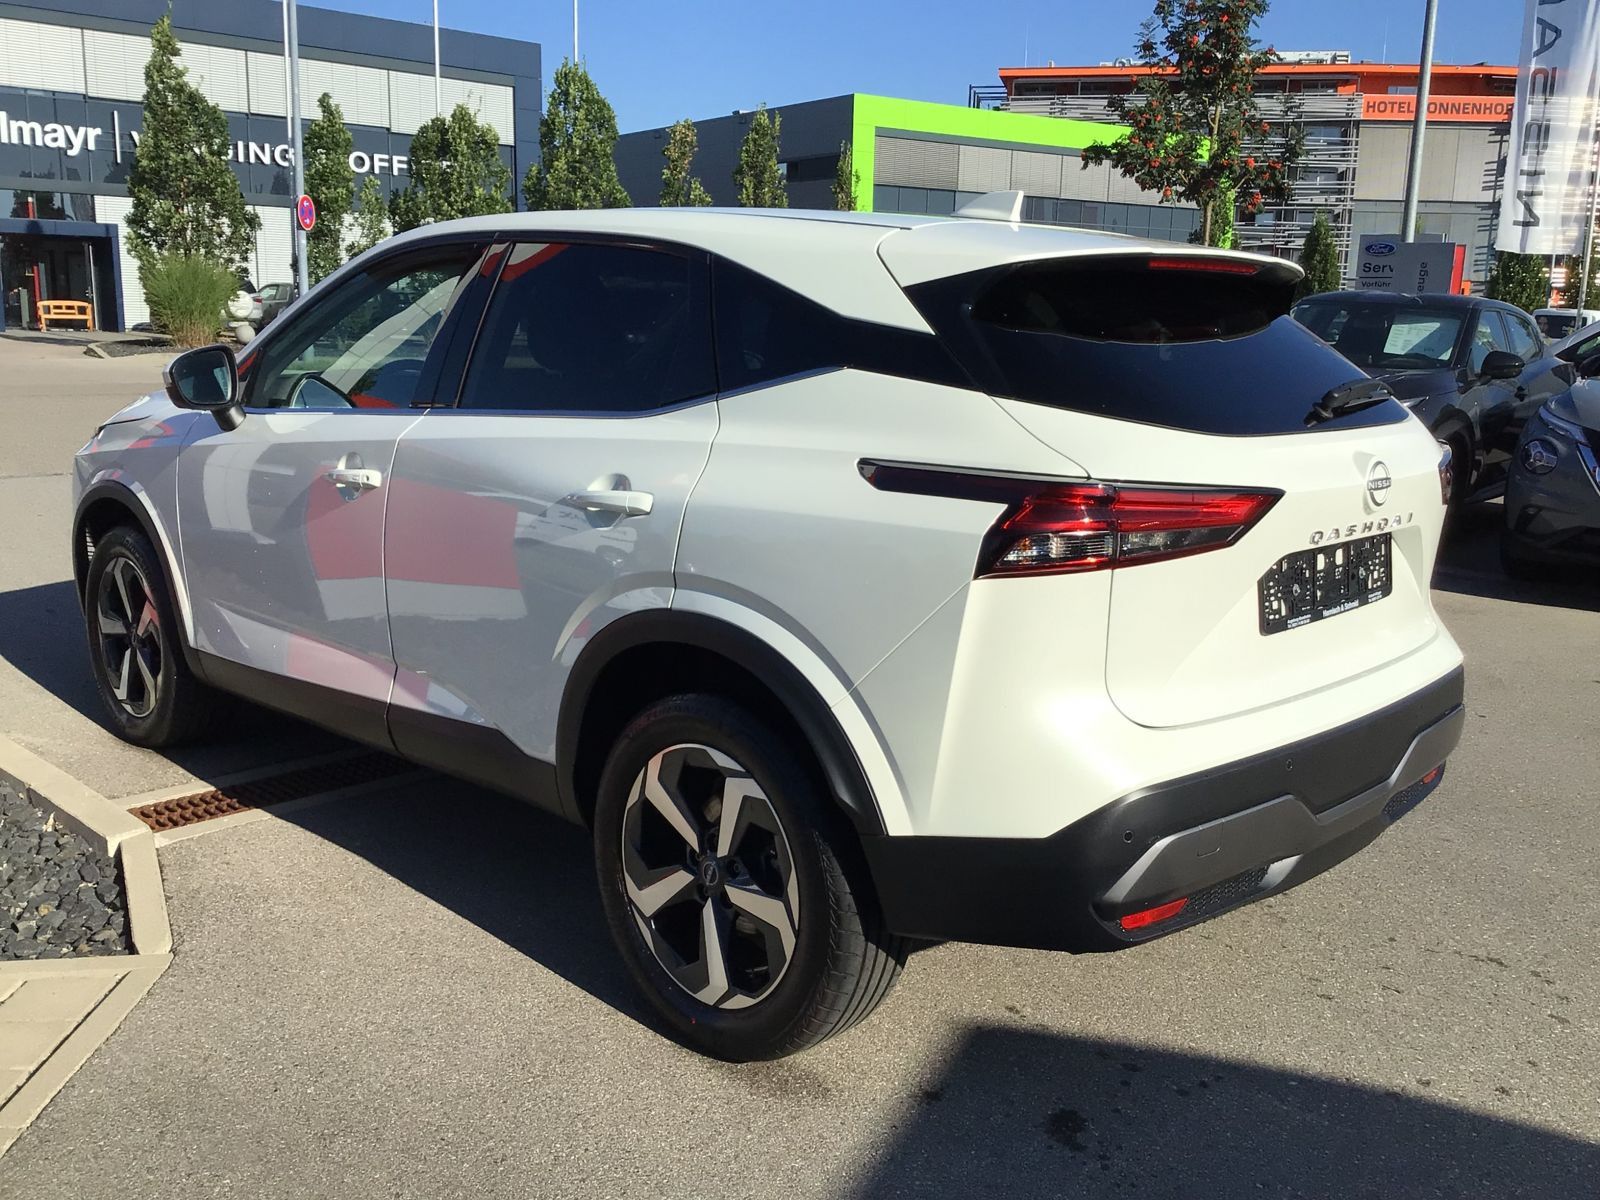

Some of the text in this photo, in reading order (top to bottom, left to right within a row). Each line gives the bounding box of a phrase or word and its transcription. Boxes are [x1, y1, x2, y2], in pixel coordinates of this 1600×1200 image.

[1366, 101, 1514, 115] HOTEL ONNENHOF
[1310, 512, 1413, 545] QASHQAI
